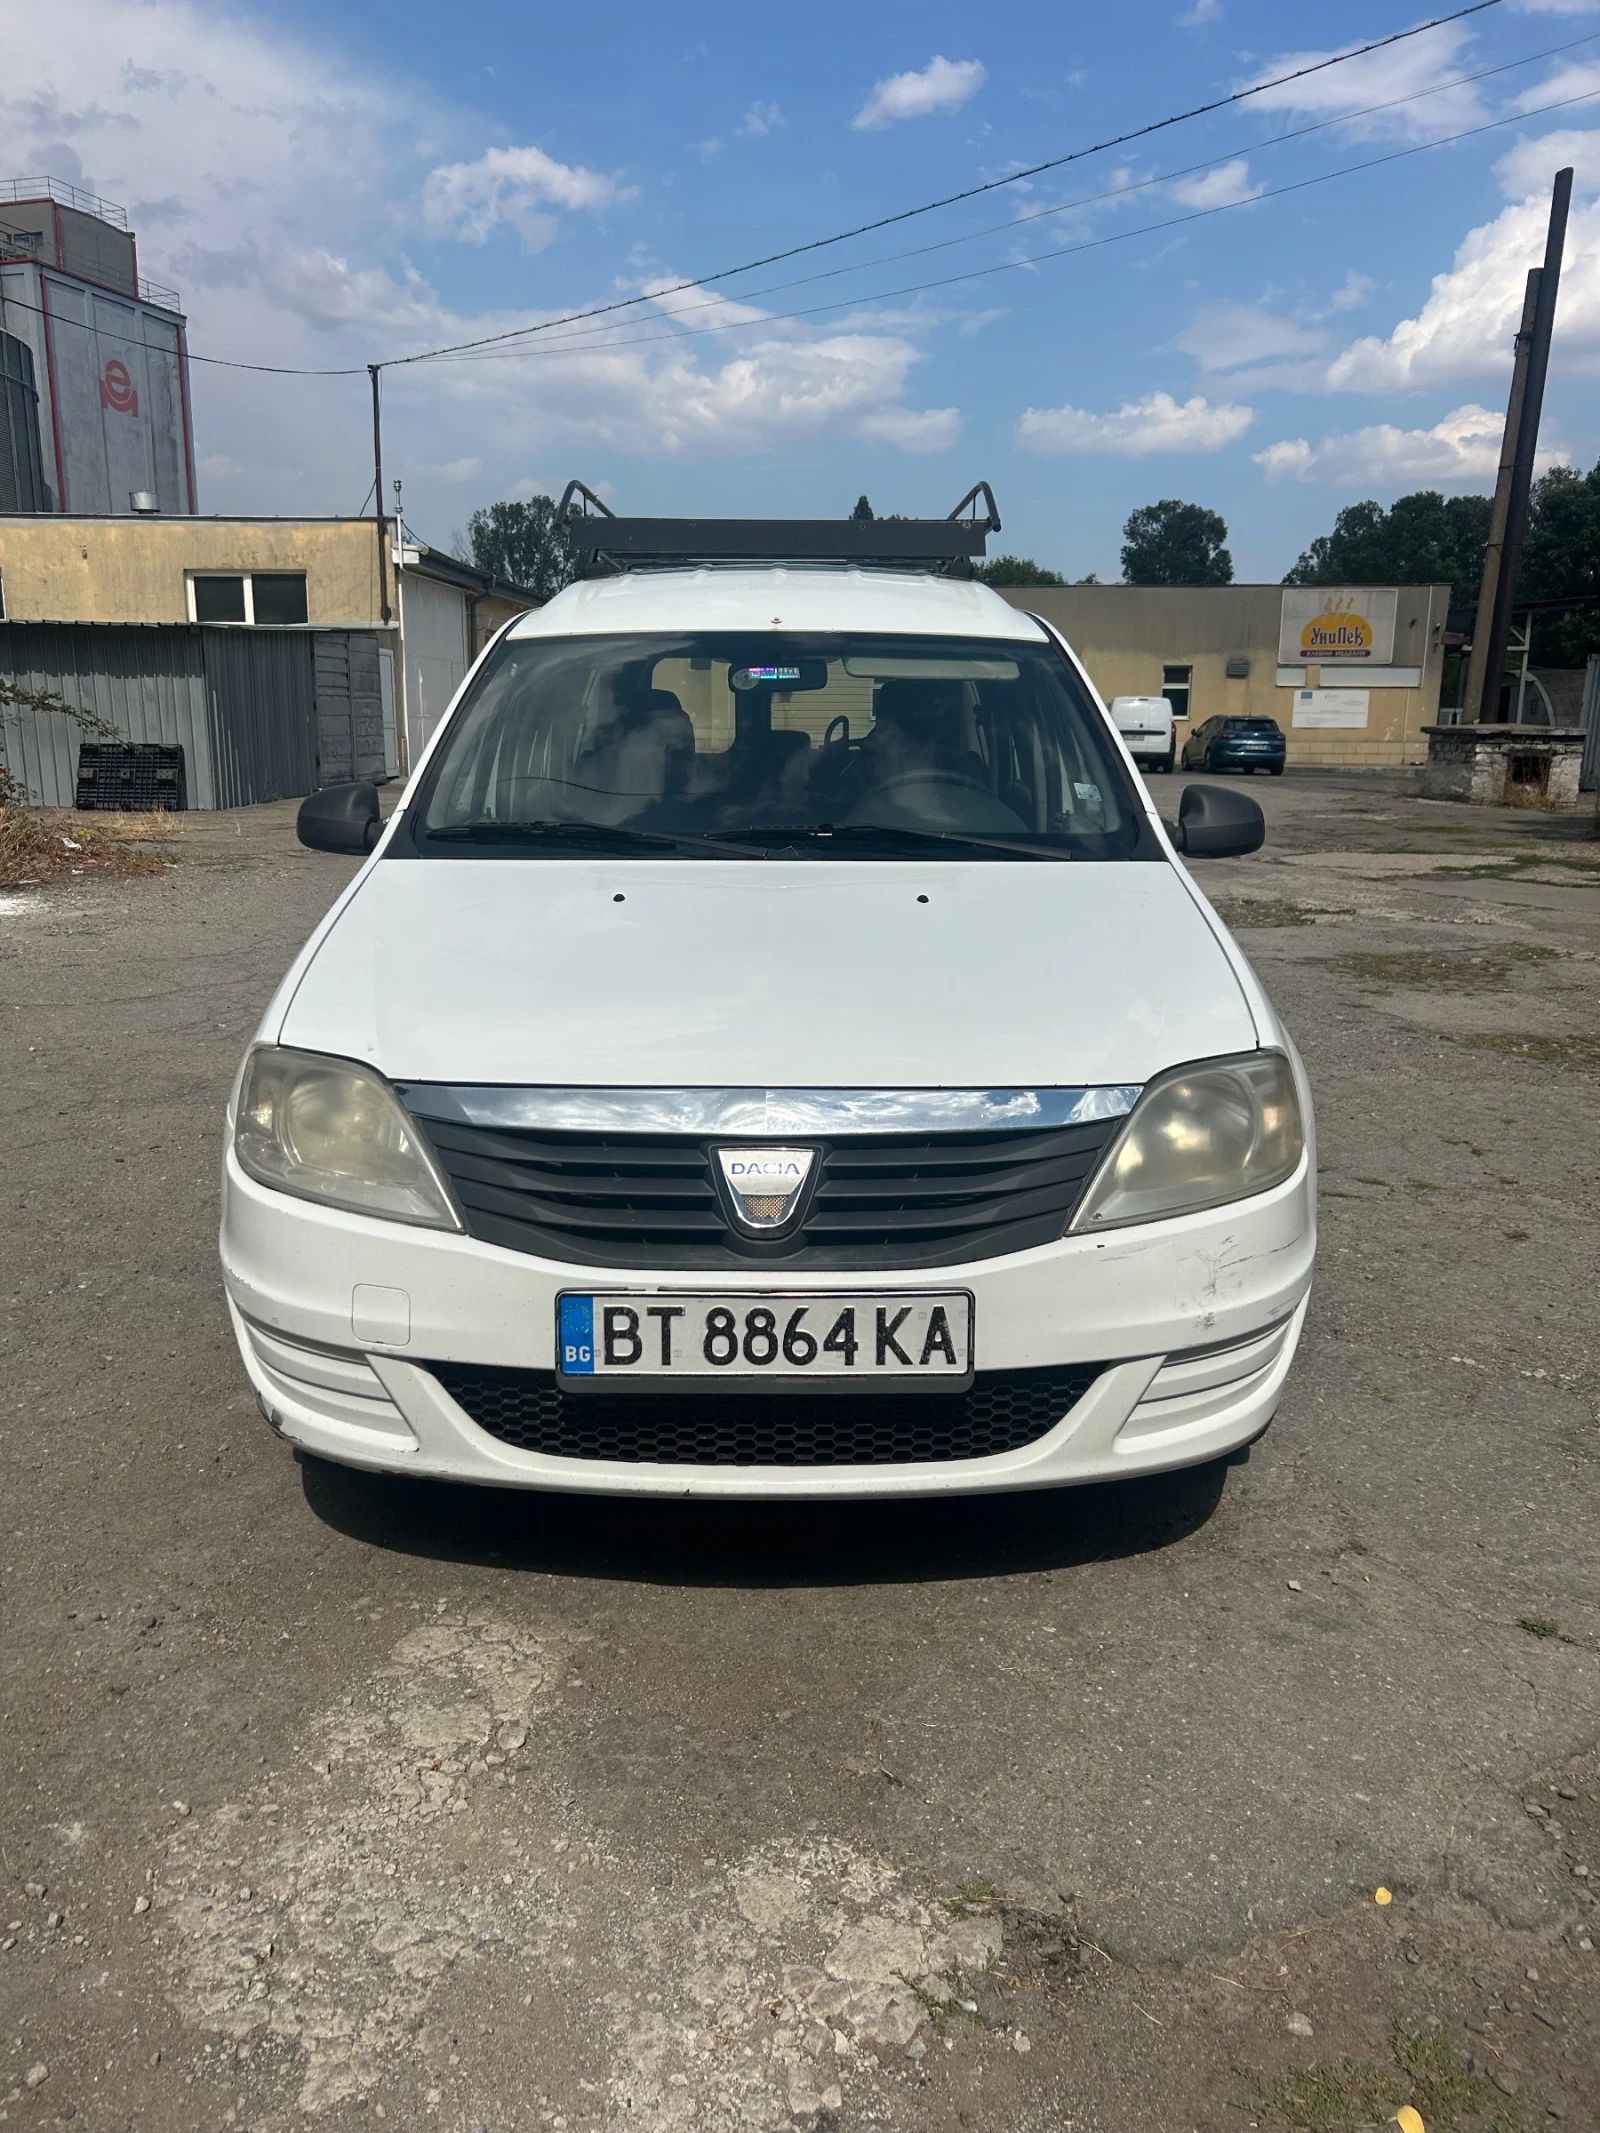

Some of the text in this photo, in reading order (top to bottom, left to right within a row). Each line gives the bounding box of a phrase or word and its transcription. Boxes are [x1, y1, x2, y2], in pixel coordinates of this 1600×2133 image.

[1310, 626, 1364, 647] УниПек
[731, 1162, 801, 1175] DACIA
[603, 1305, 957, 1366] BT 8864 KA
[565, 1345, 591, 1363] BG
